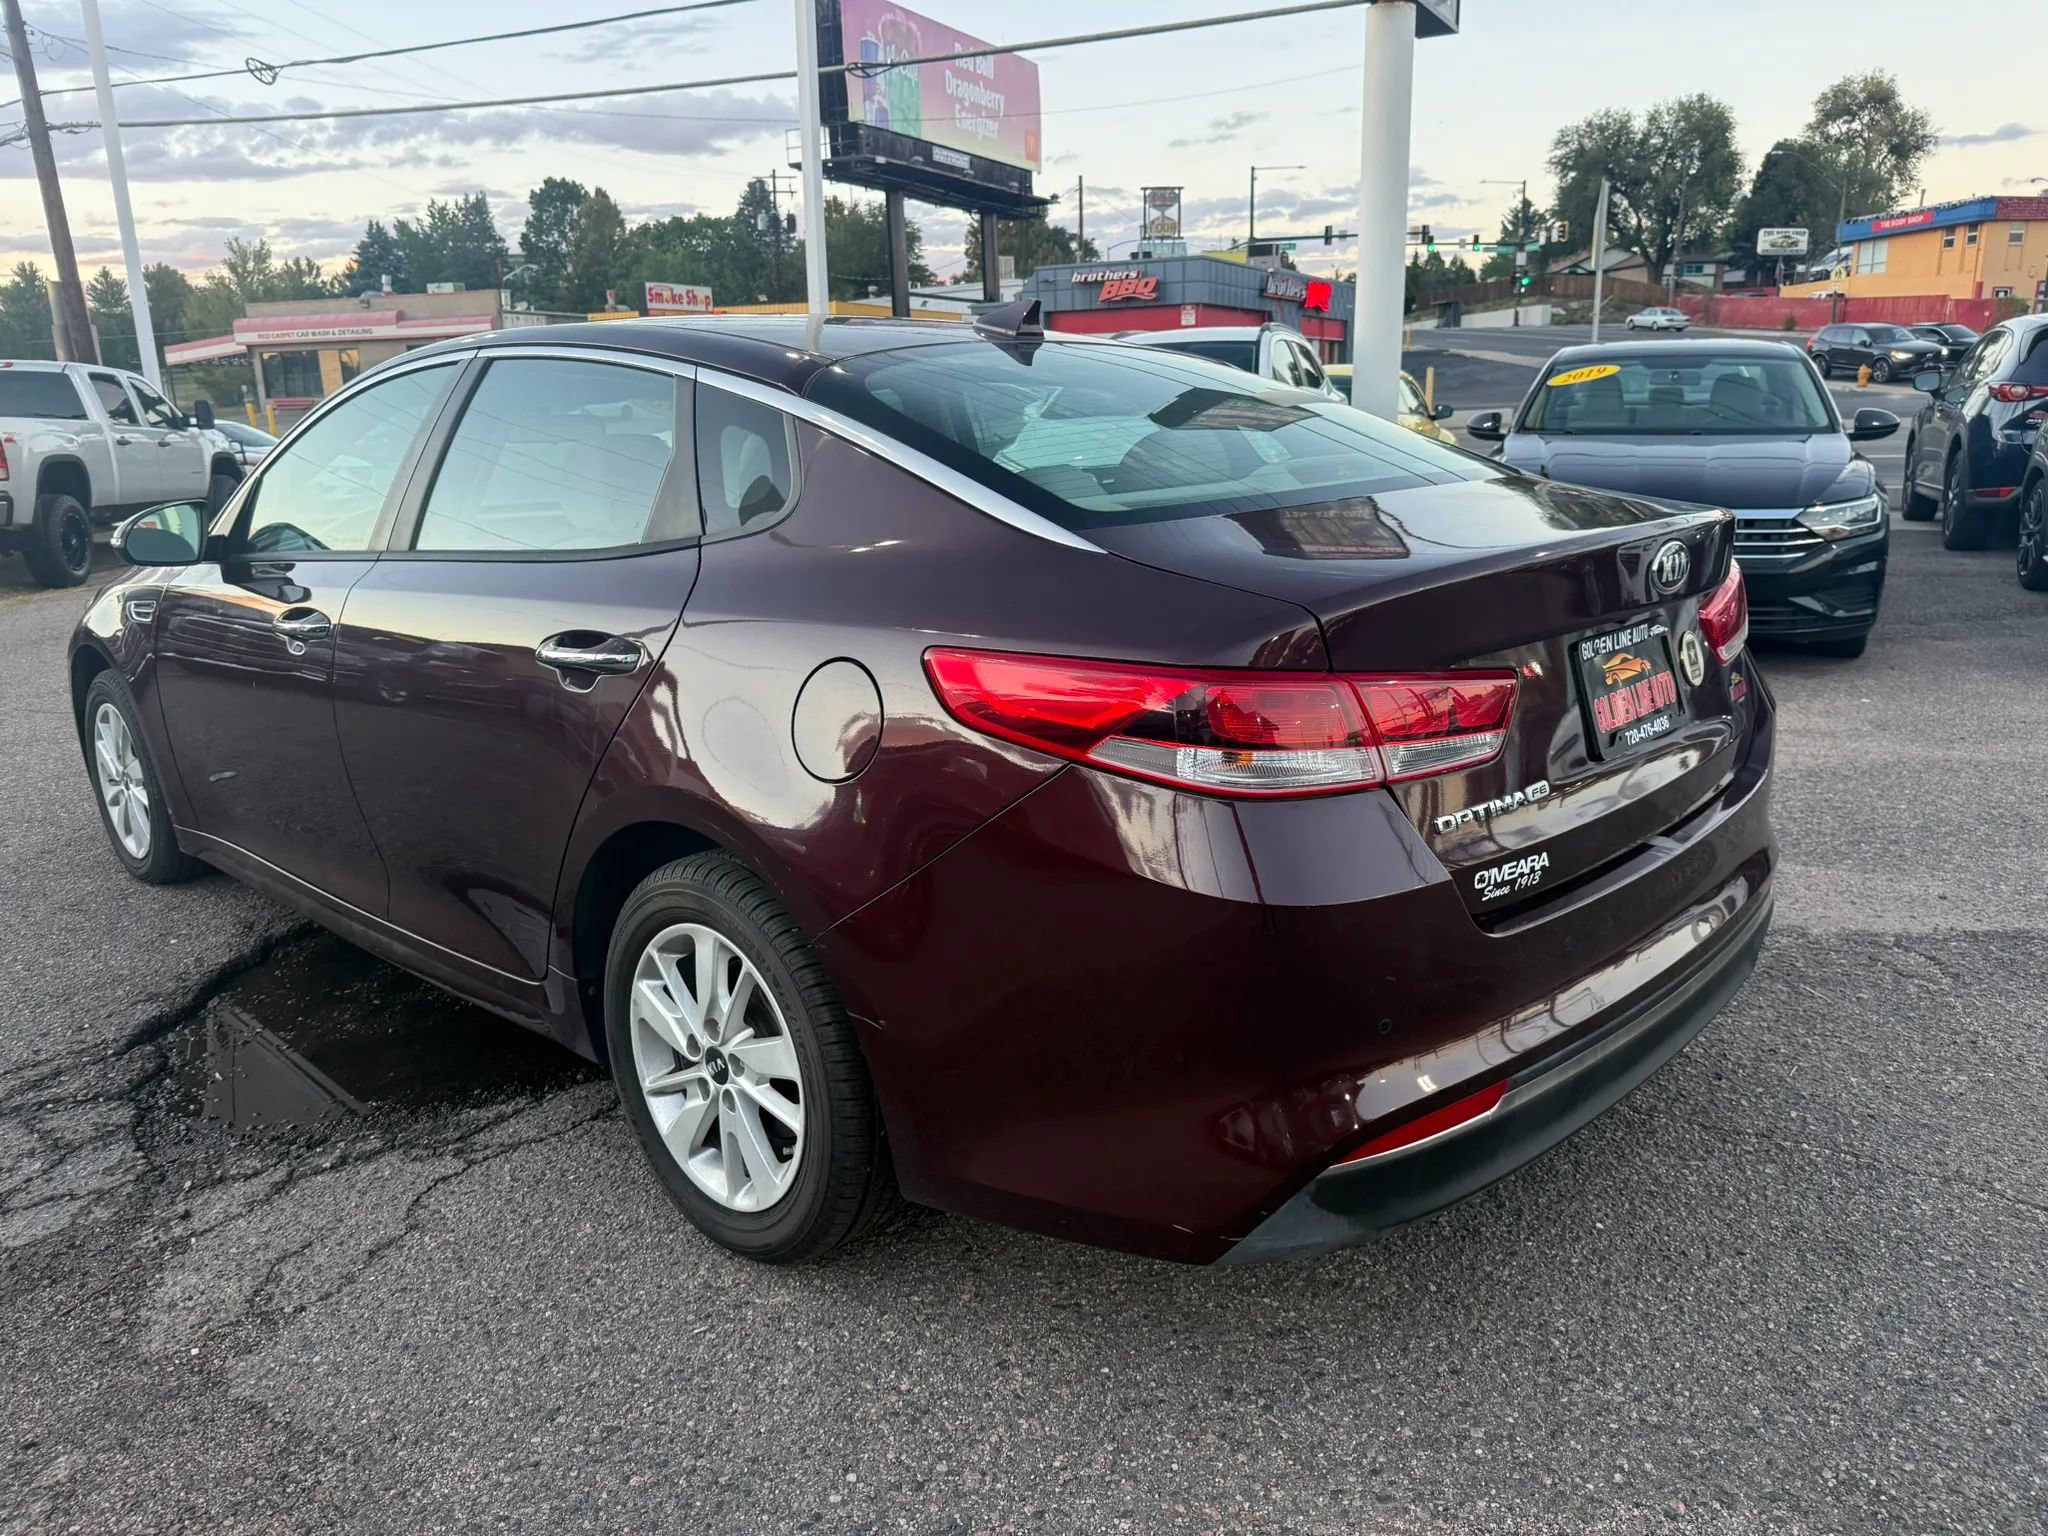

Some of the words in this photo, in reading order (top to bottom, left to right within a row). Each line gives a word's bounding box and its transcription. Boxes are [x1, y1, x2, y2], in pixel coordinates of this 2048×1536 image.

[945, 69, 1004, 117] Dragonberry
[955, 103, 999, 141] Energizer
[1071, 270, 1139, 283] brothers
[1099, 277, 1159, 301] BBQ
[271, 331, 295, 339] CARPET
[311, 330, 330, 338] WASH
[338, 328, 373, 336] DETAILING
[1561, 367, 1608, 384] 2019
[1614, 628, 1632, 650] LINE
[1633, 623, 1649, 644] AUTO
[1625, 716, 1670, 745] 720-476-4036
[1434, 791, 1528, 835] OPTIMA
[1474, 852, 1549, 889] O'MEARA
[1482, 885, 1511, 901] Since
[1515, 871, 1542, 891] 1913
[707, 1058, 726, 1077] KIA
